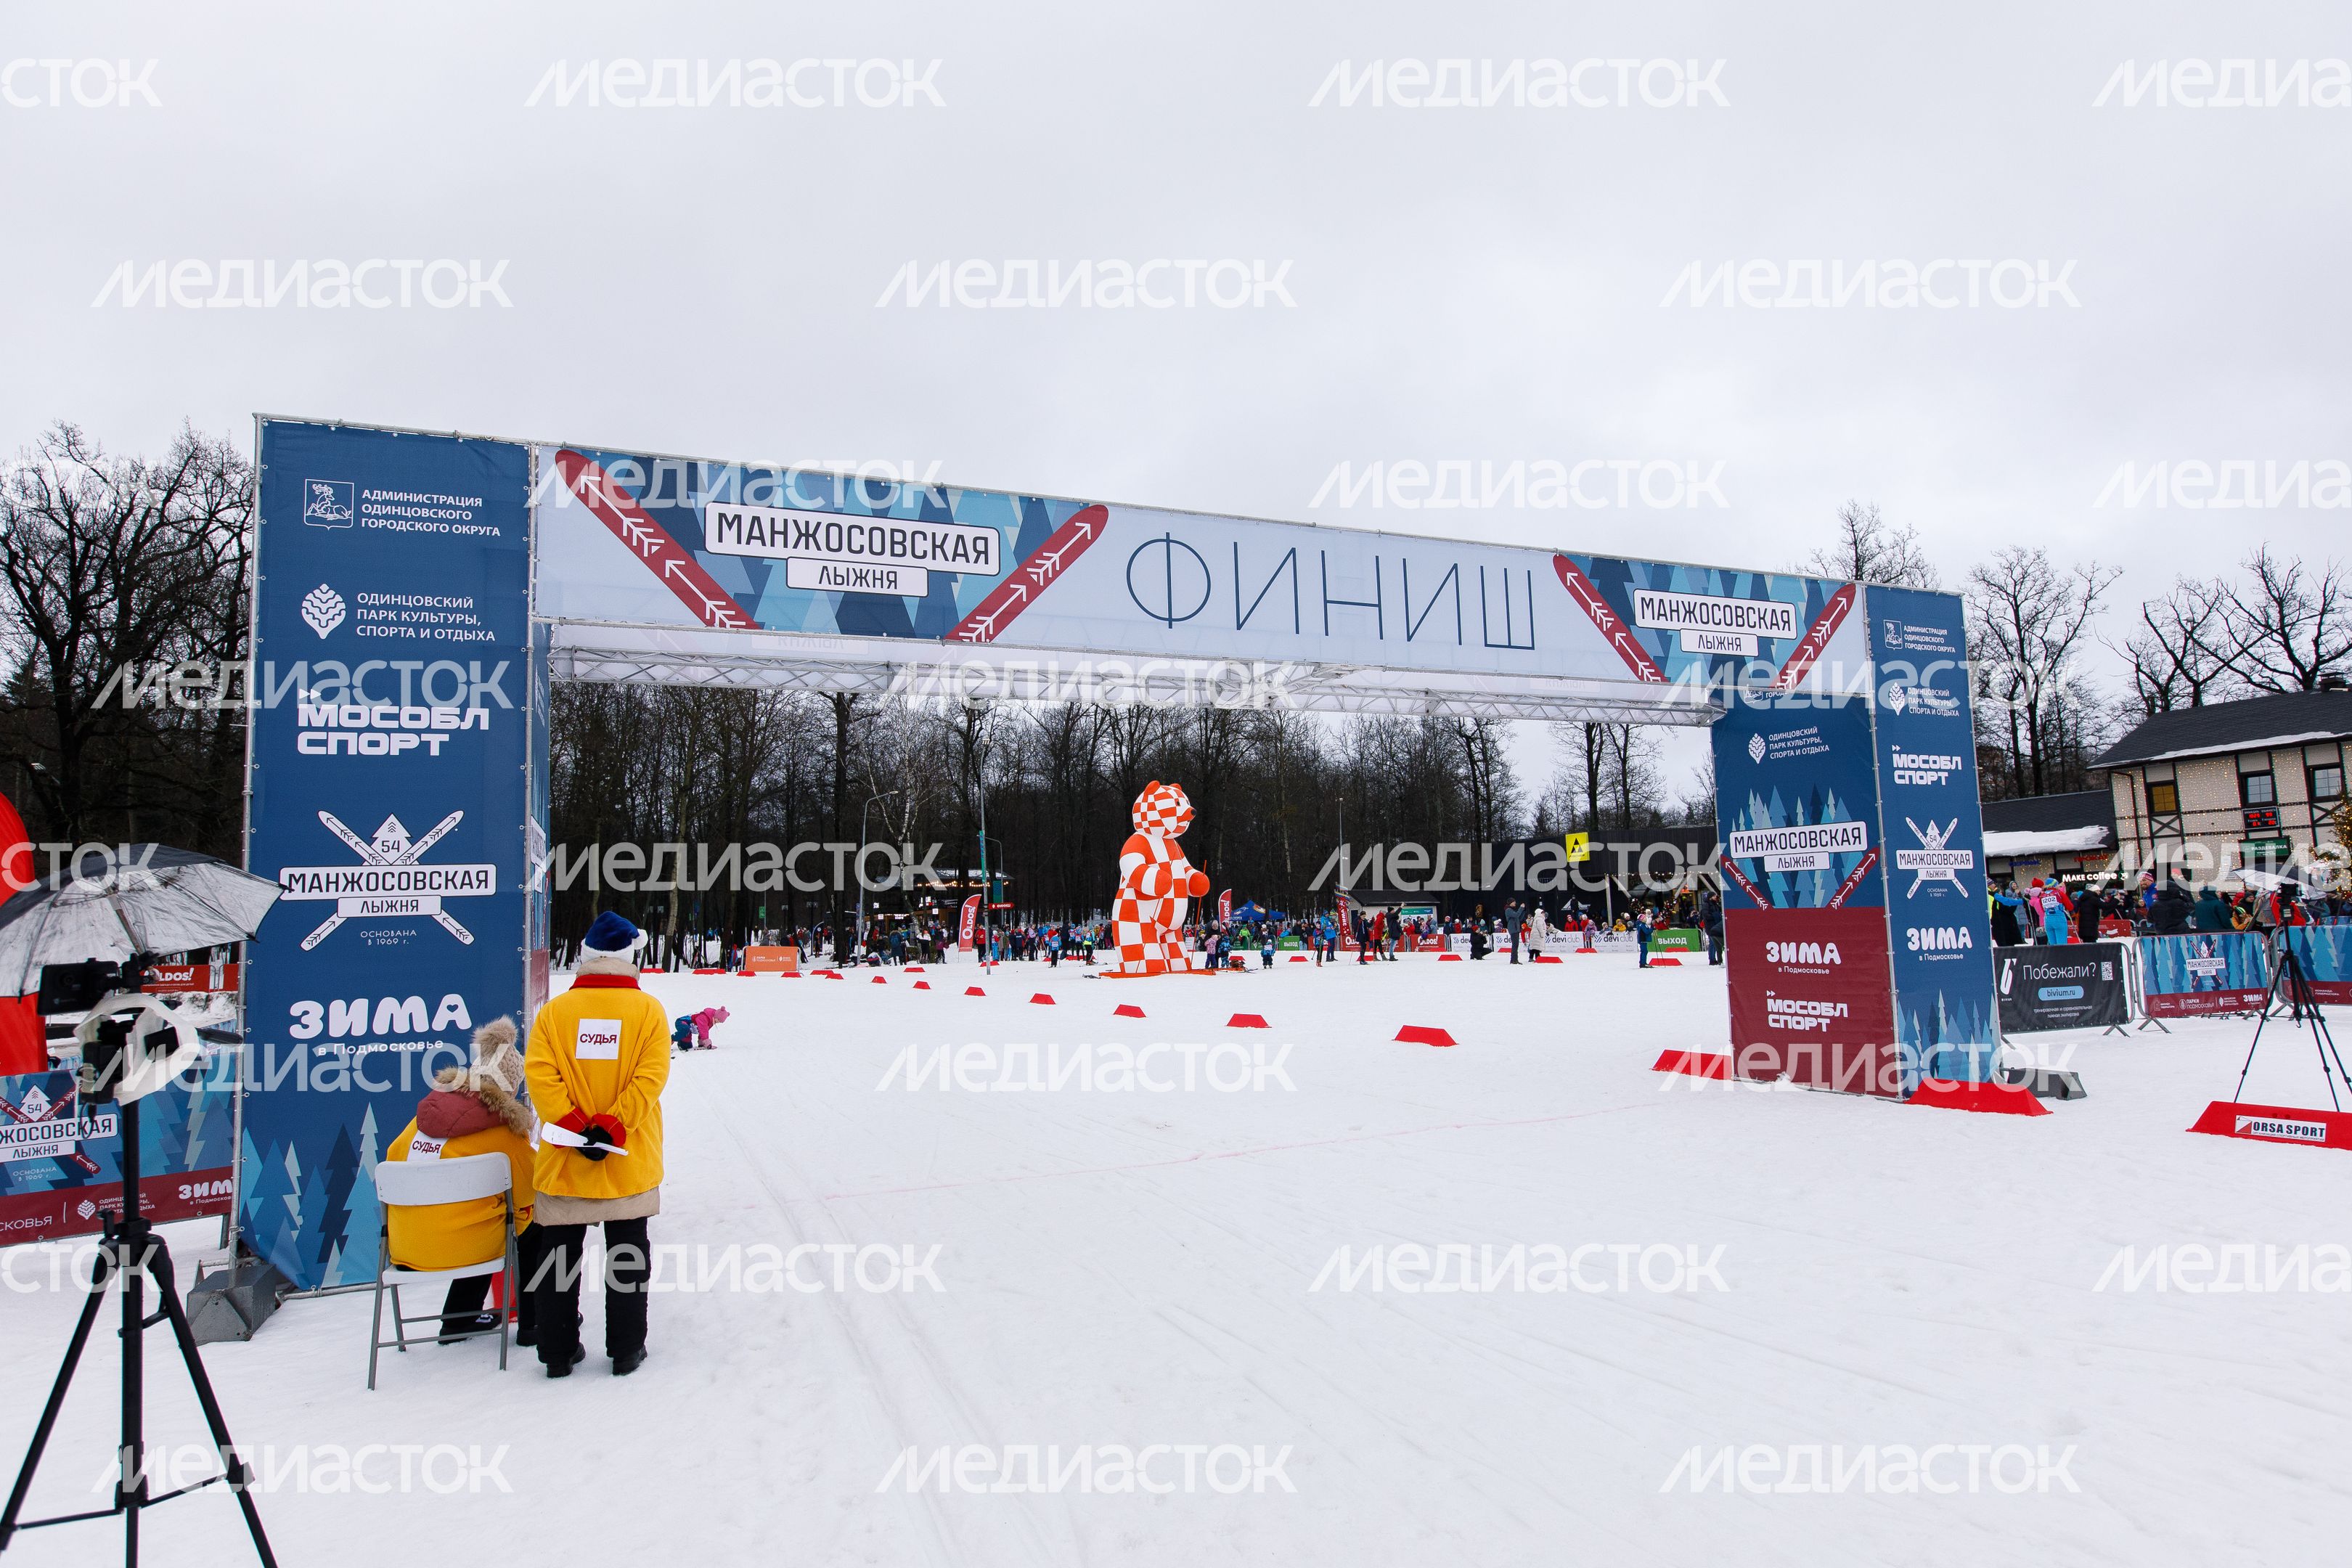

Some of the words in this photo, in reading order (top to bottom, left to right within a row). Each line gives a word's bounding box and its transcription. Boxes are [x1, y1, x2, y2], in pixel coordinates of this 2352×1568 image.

[362, 489, 482, 507] АДМИНИСТРАЦИЯ
[362, 504, 472, 520] ОДИНЦОВСКОГО
[362, 518, 449, 533] ГОРОДСКОГО
[452, 524, 501, 536] ОКРУГА
[716, 511, 990, 565] МАНЖОСОВСКАЯ
[818, 565, 899, 590] ЛЫЖНЯ
[1126, 532, 1536, 650] ФИНИШ
[357, 592, 473, 609] ОДИНЦОВСКИЙ
[357, 610, 397, 621] ПАРК
[401, 611, 481, 626] КУЛЬТУРЫ,
[1641, 597, 1792, 632] МАНЖОСОВСКАЯ
[356, 626, 416, 637] СПОРТА
[420, 628, 430, 639] И
[434, 629, 496, 642] ОТДЫХА
[1903, 626, 1948, 635] АДМИНИСТРАЦИЯ
[1697, 633, 1743, 653] ЛЫЖНЯ
[1904, 634, 1945, 644] ОДИНЦОВСКОГО
[1905, 642, 1937, 651] ГОРОДСКОГО
[1908, 687, 1950, 697] ОДИНЦОВСКИЙ
[1924, 698, 1953, 707] КУЛЬТУРЫ,
[298, 703, 489, 730] МОСОБЛ
[1768, 726, 1818, 741] ОДИНЦОВСКИЙ
[298, 731, 449, 756] СПОРТ
[1787, 736, 1822, 748] КУЛЬТУРЫ,
[1770, 750, 1794, 759] СПОРТА
[1802, 745, 1829, 754] ОТДЫХА
[1892, 754, 1962, 770] МОСОБЛ
[1894, 770, 1949, 785] СПОРТ
[381, 839, 401, 854] 54
[1734, 826, 1861, 853] МАНЖОСОВСКАЯ
[1778, 856, 1815, 869] ЛЫЖНЯ
[1899, 853, 1971, 865] МАНЖОСОВСКАЯ
[288, 870, 489, 894] МАНЖОСОВСКАЯ
[1926, 870, 1947, 878] ЛЫЖНЯ
[2062, 874, 2086, 883] MAKE
[2086, 872, 2117, 881] coffee
[360, 898, 420, 914] ЛЫЖНЯ
[963, 905, 976, 939] OLDOS!
[360, 929, 417, 938] ОСНОВАНА
[1552, 933, 1567, 943] devi
[1567, 934, 1580, 943] club
[1604, 934, 1619, 942] devi
[1620, 932, 1633, 942] club
[1906, 926, 1972, 951] ЗИМА
[1765, 942, 1841, 965] ЗИМА
[1924, 952, 1964, 962] Подмосковье
[1784, 965, 1829, 975] Подмосковье
[2023, 962, 2096, 980] Побежали?
[2187, 959, 2224, 968] МАНЖОСОВСКАЯ
[1767, 998, 1848, 1018] МОСОБЛ
[290, 993, 473, 1040] ЗИМА
[1768, 1014, 1830, 1032] СПОРТ
[579, 1033, 617, 1044] СУДЬЯ
[318, 1047, 327, 1055] в
[333, 1039, 444, 1056] Подмосковье
[28, 1103, 42, 1114] 54
[0, 1118, 111, 1144] ЖОСОВСКАЯ
[2253, 1122, 2284, 1133] ORSA
[2286, 1124, 2325, 1138] SPORT
[13, 1144, 59, 1159] ЛЫЖНЯ
[412, 1140, 441, 1154] СУДЬЯ
[13, 1167, 57, 1177] ОСНОВАНА
[179, 1179, 232, 1199] ЗИМ
[196, 1196, 232, 1204] Подмосков
[0, 1215, 52, 1232] СКОВЬЯ
